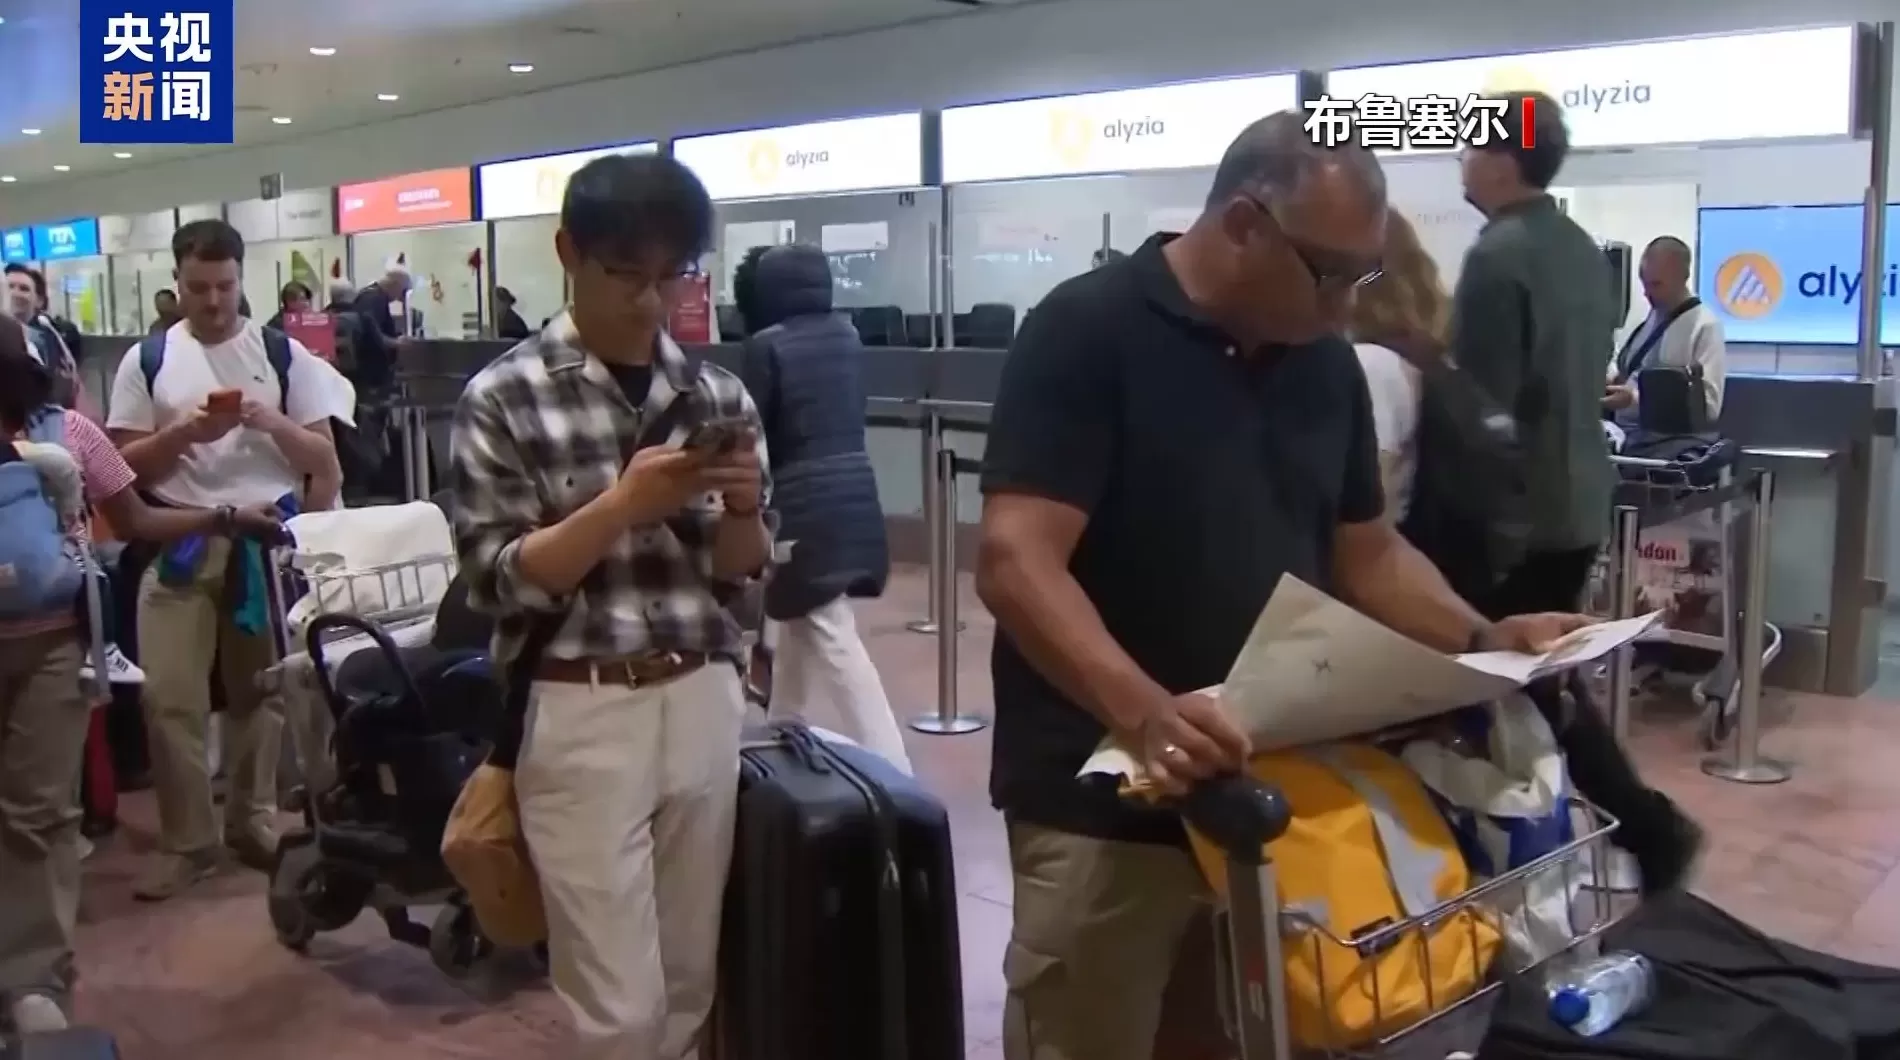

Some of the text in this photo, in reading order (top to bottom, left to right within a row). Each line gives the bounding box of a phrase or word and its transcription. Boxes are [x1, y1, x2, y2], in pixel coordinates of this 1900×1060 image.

[1563, 79, 1650, 113] alyzia
[1103, 115, 1164, 143] alyzia
[786, 149, 829, 170] alyzia
